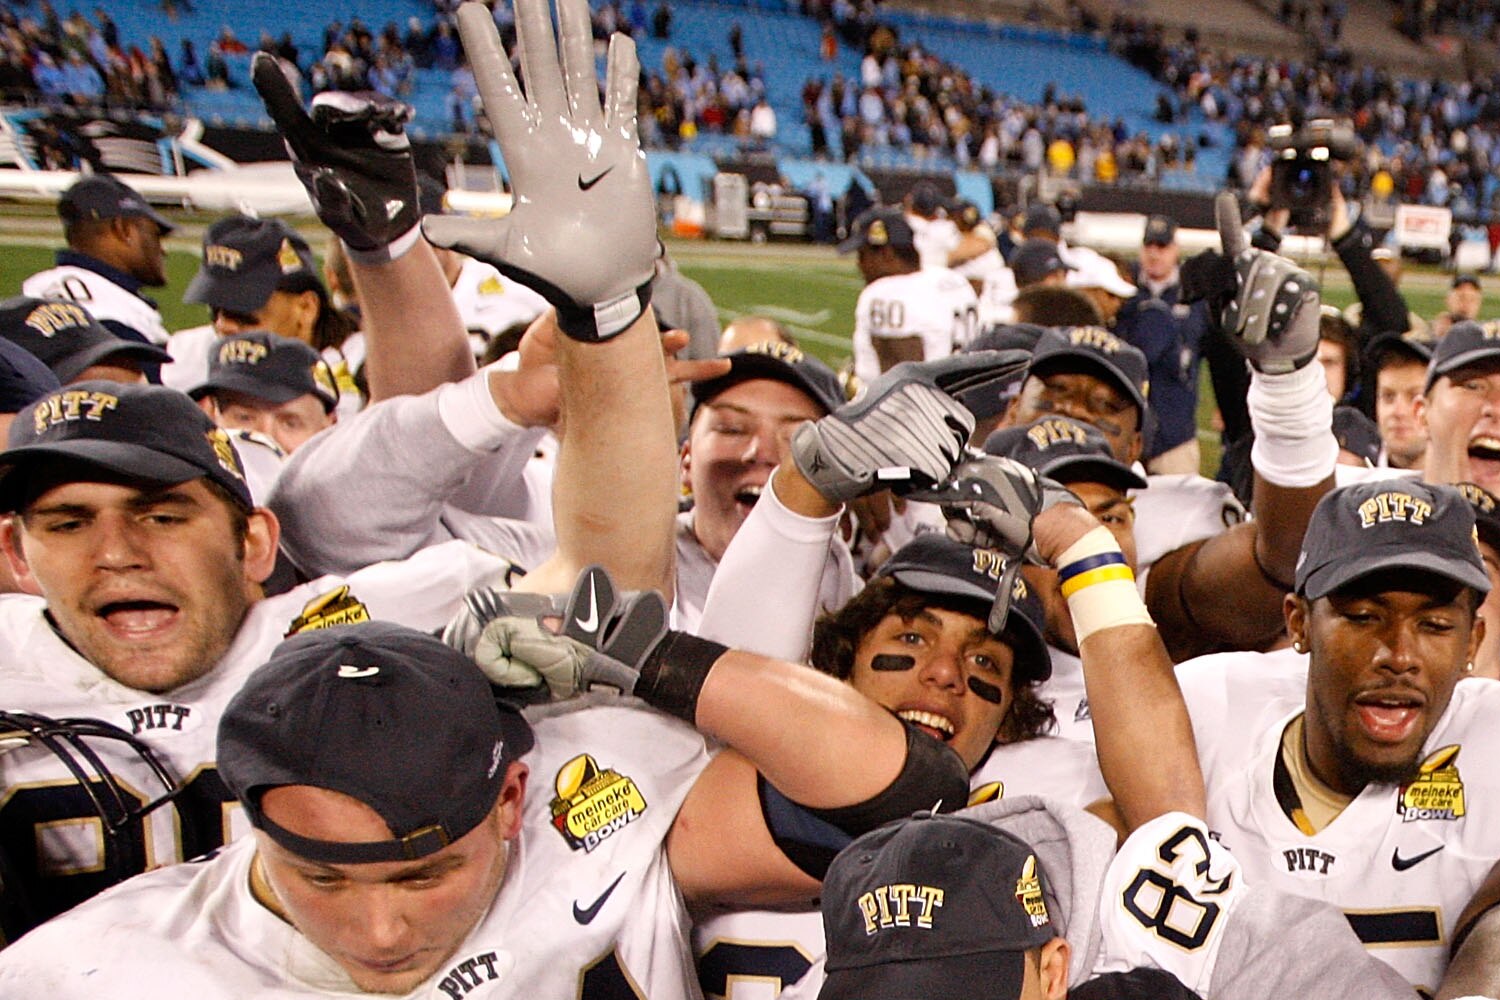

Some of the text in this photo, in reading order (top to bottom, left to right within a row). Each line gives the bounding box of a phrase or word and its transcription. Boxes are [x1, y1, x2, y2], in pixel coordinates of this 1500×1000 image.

[1069, 326, 1121, 354] PITT
[33, 390, 118, 435] PITT
[1027, 420, 1088, 452] PITT
[1357, 493, 1432, 529] PITT
[127, 705, 190, 734] PITT
[572, 784, 632, 826] meineke
[1410, 784, 1460, 799] meineke
[604, 799, 630, 819] care
[1403, 807, 1458, 822] BOWL
[583, 807, 641, 853] BOWL
[1283, 848, 1336, 875] PITT
[857, 883, 944, 936] PITT
